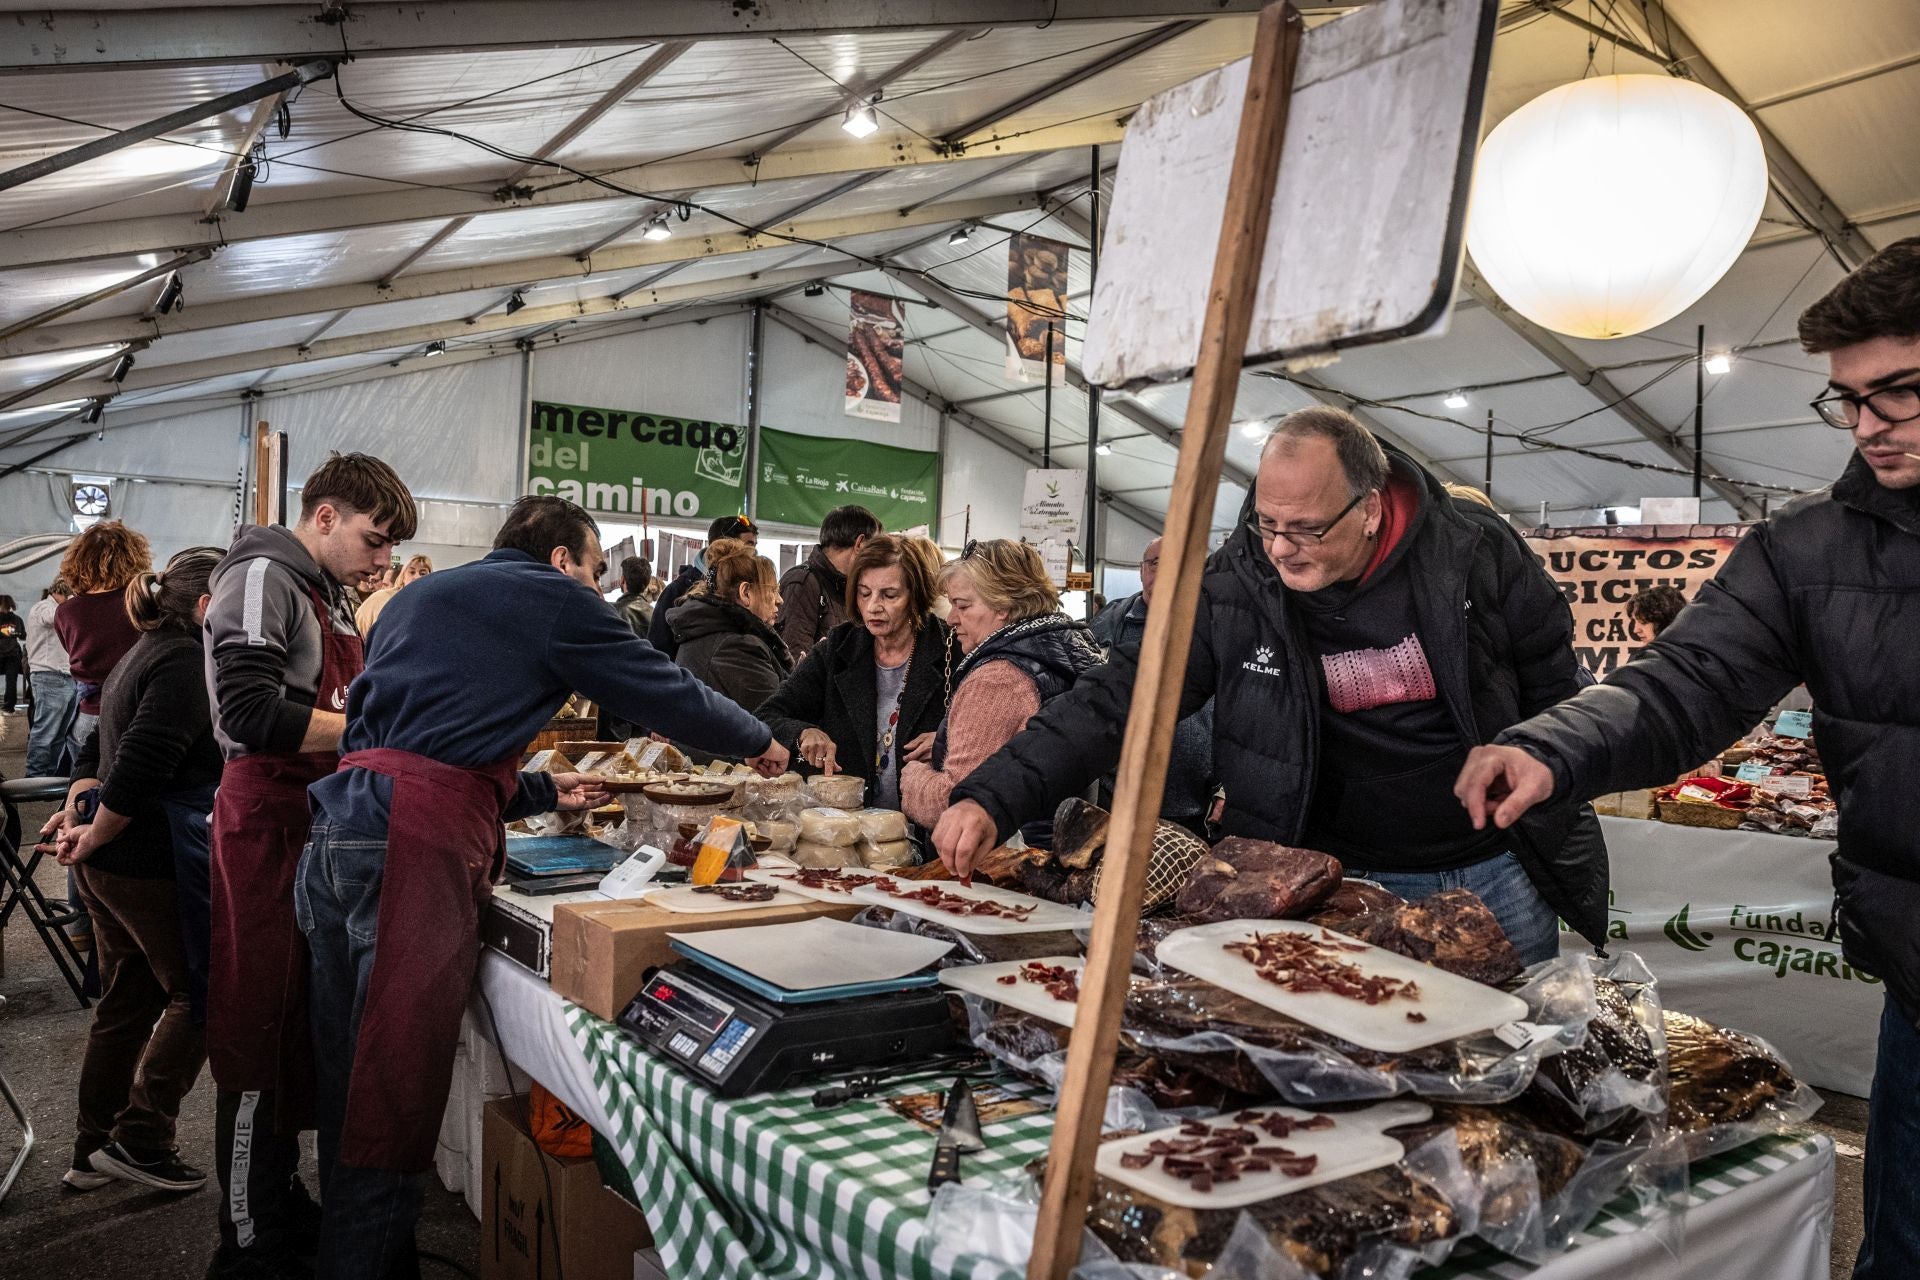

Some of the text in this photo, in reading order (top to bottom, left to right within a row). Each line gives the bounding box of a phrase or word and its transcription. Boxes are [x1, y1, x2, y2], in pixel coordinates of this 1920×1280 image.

[532, 403, 738, 452] mercado
[529, 437, 590, 471] del
[528, 476, 700, 517] camino
[850, 482, 888, 495] CaixaBank
[1242, 661, 1281, 676] KELME
[1730, 904, 1840, 940] Funda
